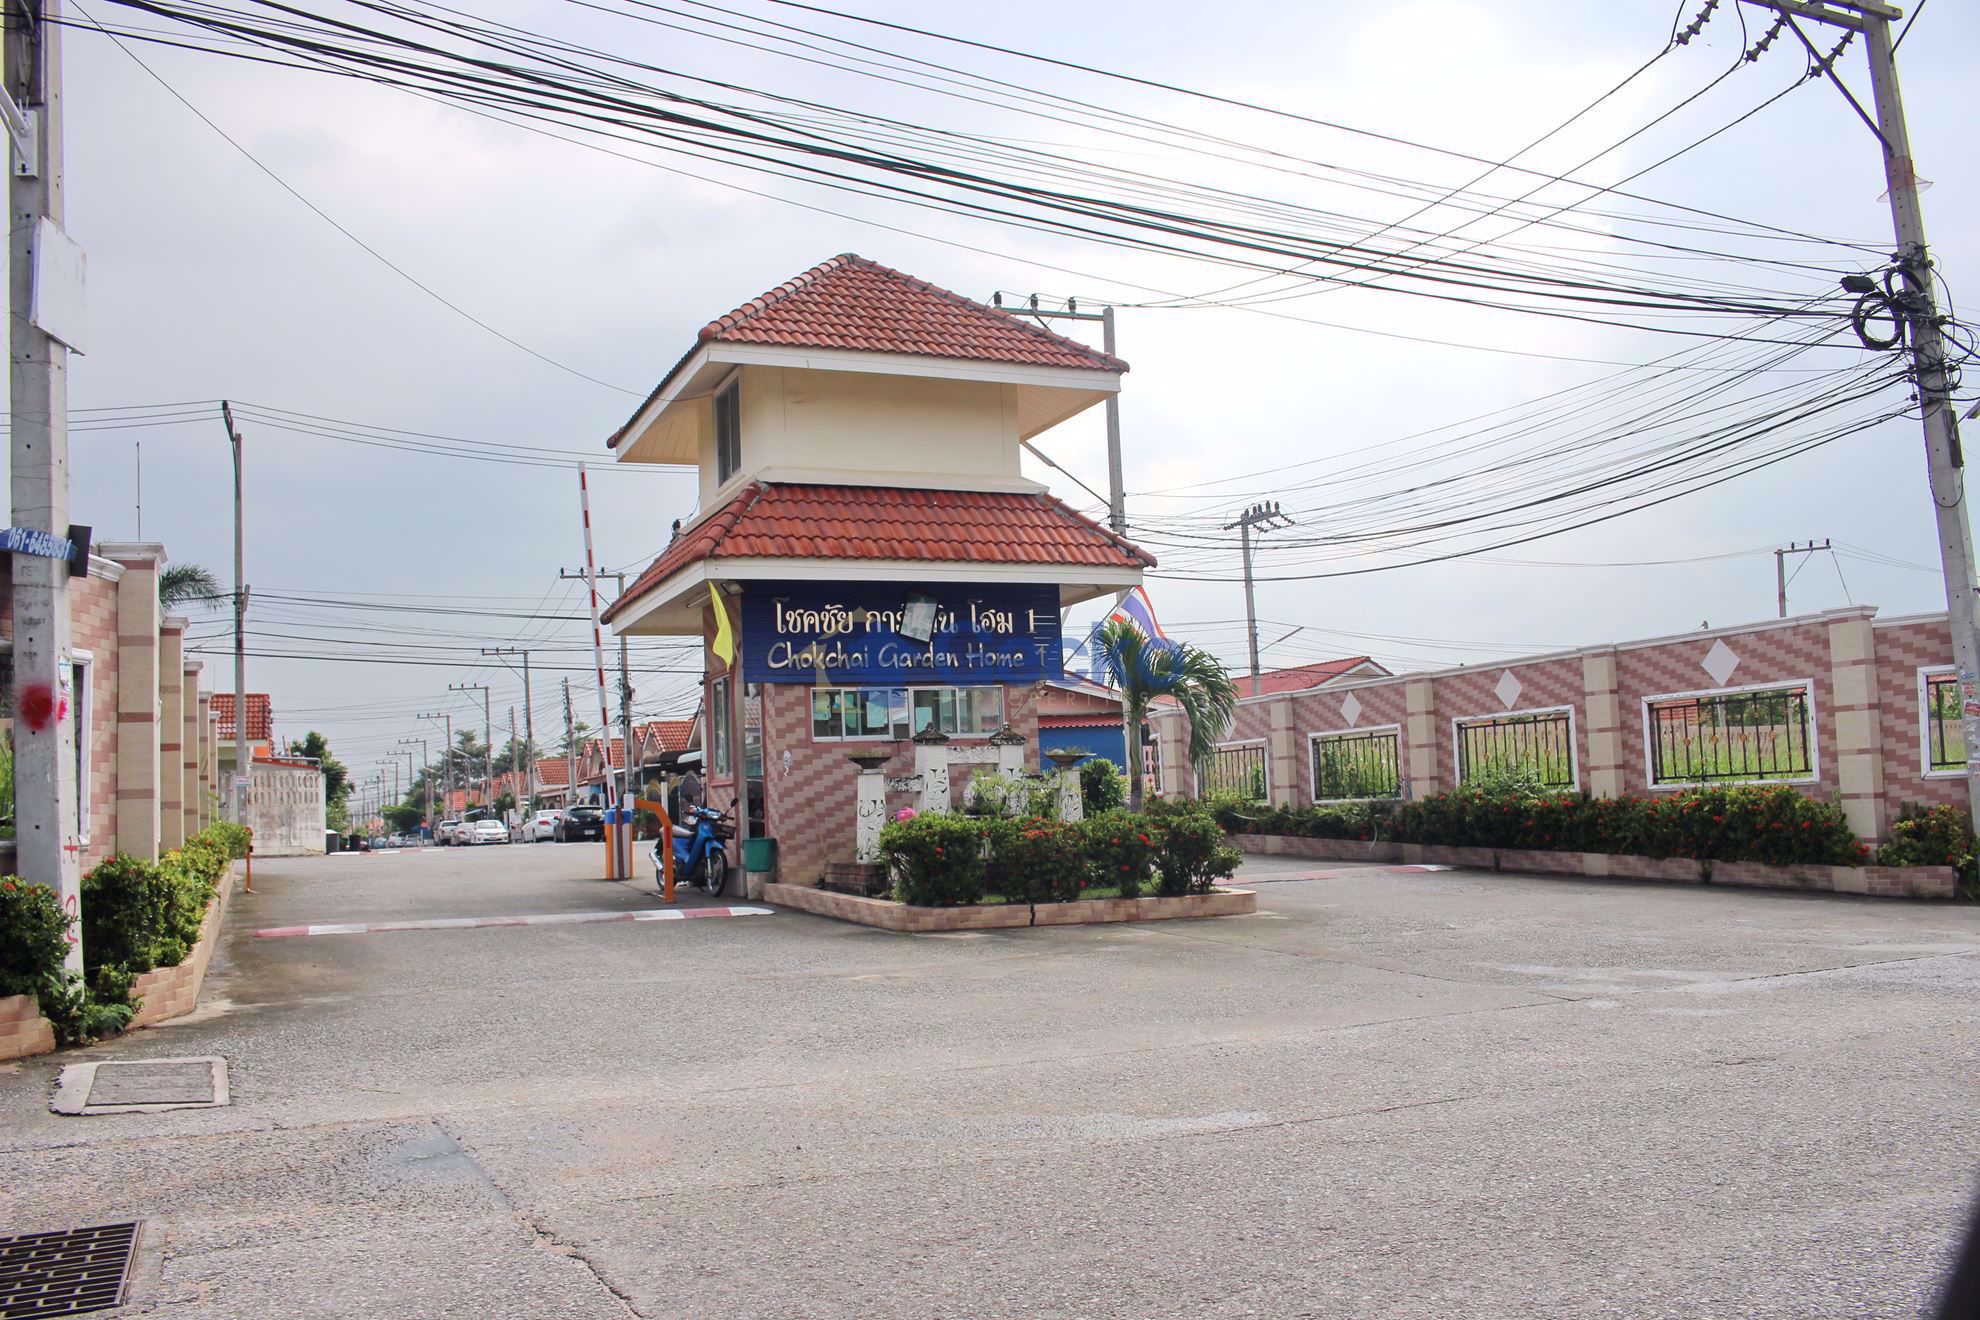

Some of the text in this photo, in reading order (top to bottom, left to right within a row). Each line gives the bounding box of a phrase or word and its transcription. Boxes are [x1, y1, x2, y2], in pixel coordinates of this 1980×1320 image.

[772, 596, 854, 634] โชคชัย
[967, 598, 1014, 634] โฮม
[1025, 608, 1037, 634] 1
[767, 641, 869, 671] Chokchai
[878, 642, 959, 670] Garden
[966, 643, 1024, 671] Home
